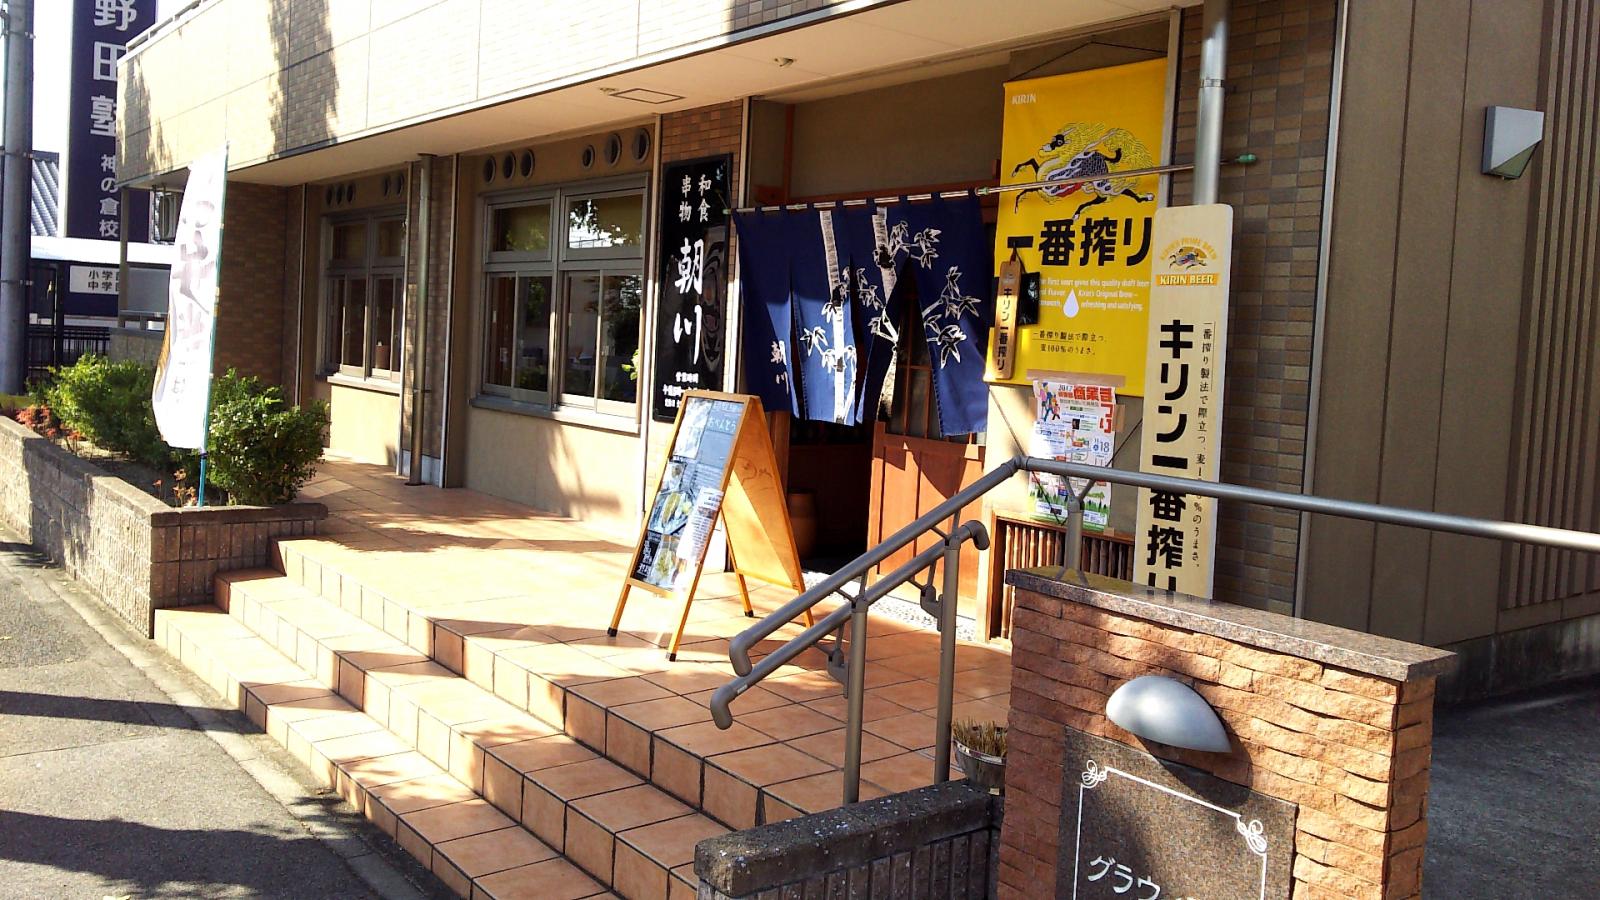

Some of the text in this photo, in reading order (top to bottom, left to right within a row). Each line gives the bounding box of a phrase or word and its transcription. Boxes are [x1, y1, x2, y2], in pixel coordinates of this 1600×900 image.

[1011, 92, 1037, 105] KIRIN
[678, 174, 693, 223] 串物
[697, 173, 712, 223] 和食
[1007, 216, 1153, 267] 一番搾り
[674, 236, 704, 366] 朝川
[1160, 274, 1214, 286] KIRIN BEER
[996, 287, 1013, 371] キリン一番搾り
[1058, 384, 1073, 392] 2017
[1100, 441, 1110, 453] 18
[1191, 322, 1213, 568] 一番搾り製法で際立つ、麦1%のうまさ。
